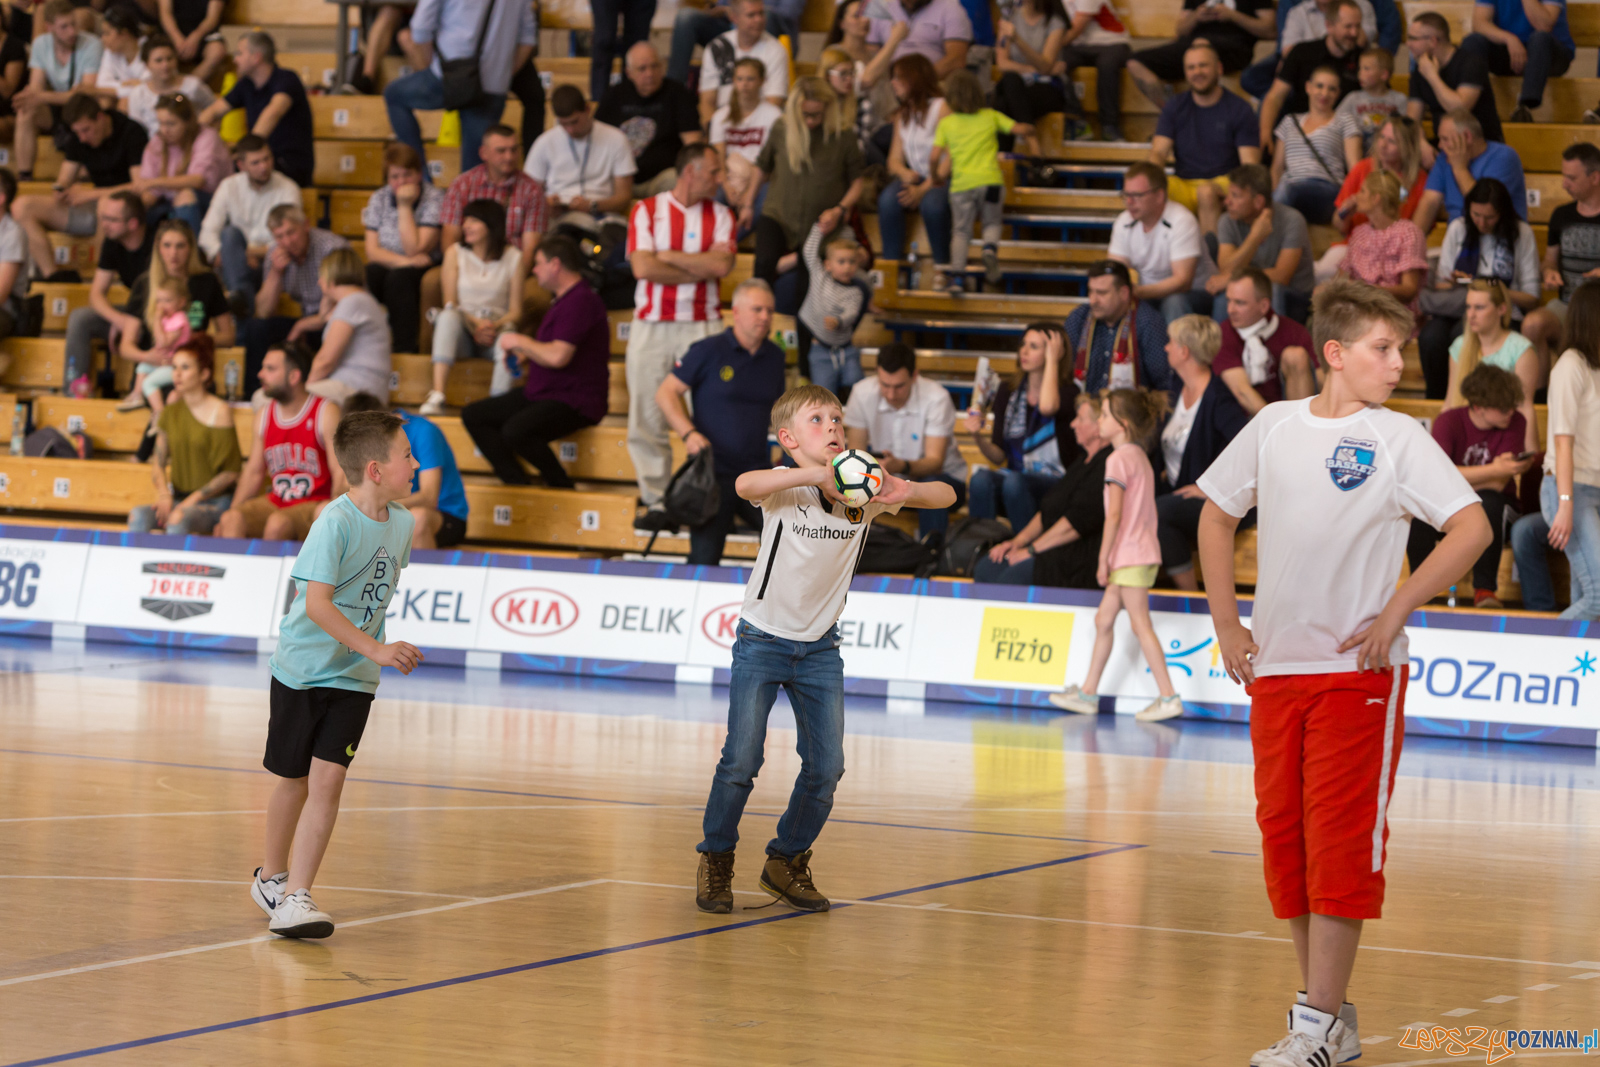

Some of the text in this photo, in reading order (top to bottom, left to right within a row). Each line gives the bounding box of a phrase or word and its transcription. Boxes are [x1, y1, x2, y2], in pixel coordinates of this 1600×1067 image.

[264, 442, 321, 476] BULLS
[1325, 458, 1377, 476] BASKET
[496, 507, 511, 522] 10
[586, 513, 595, 526] 9
[373, 561, 387, 579] B
[149, 578, 210, 599] JOKER
[506, 598, 562, 626] KIA
[601, 604, 686, 634] DELIK
[991, 626, 1020, 643] pro
